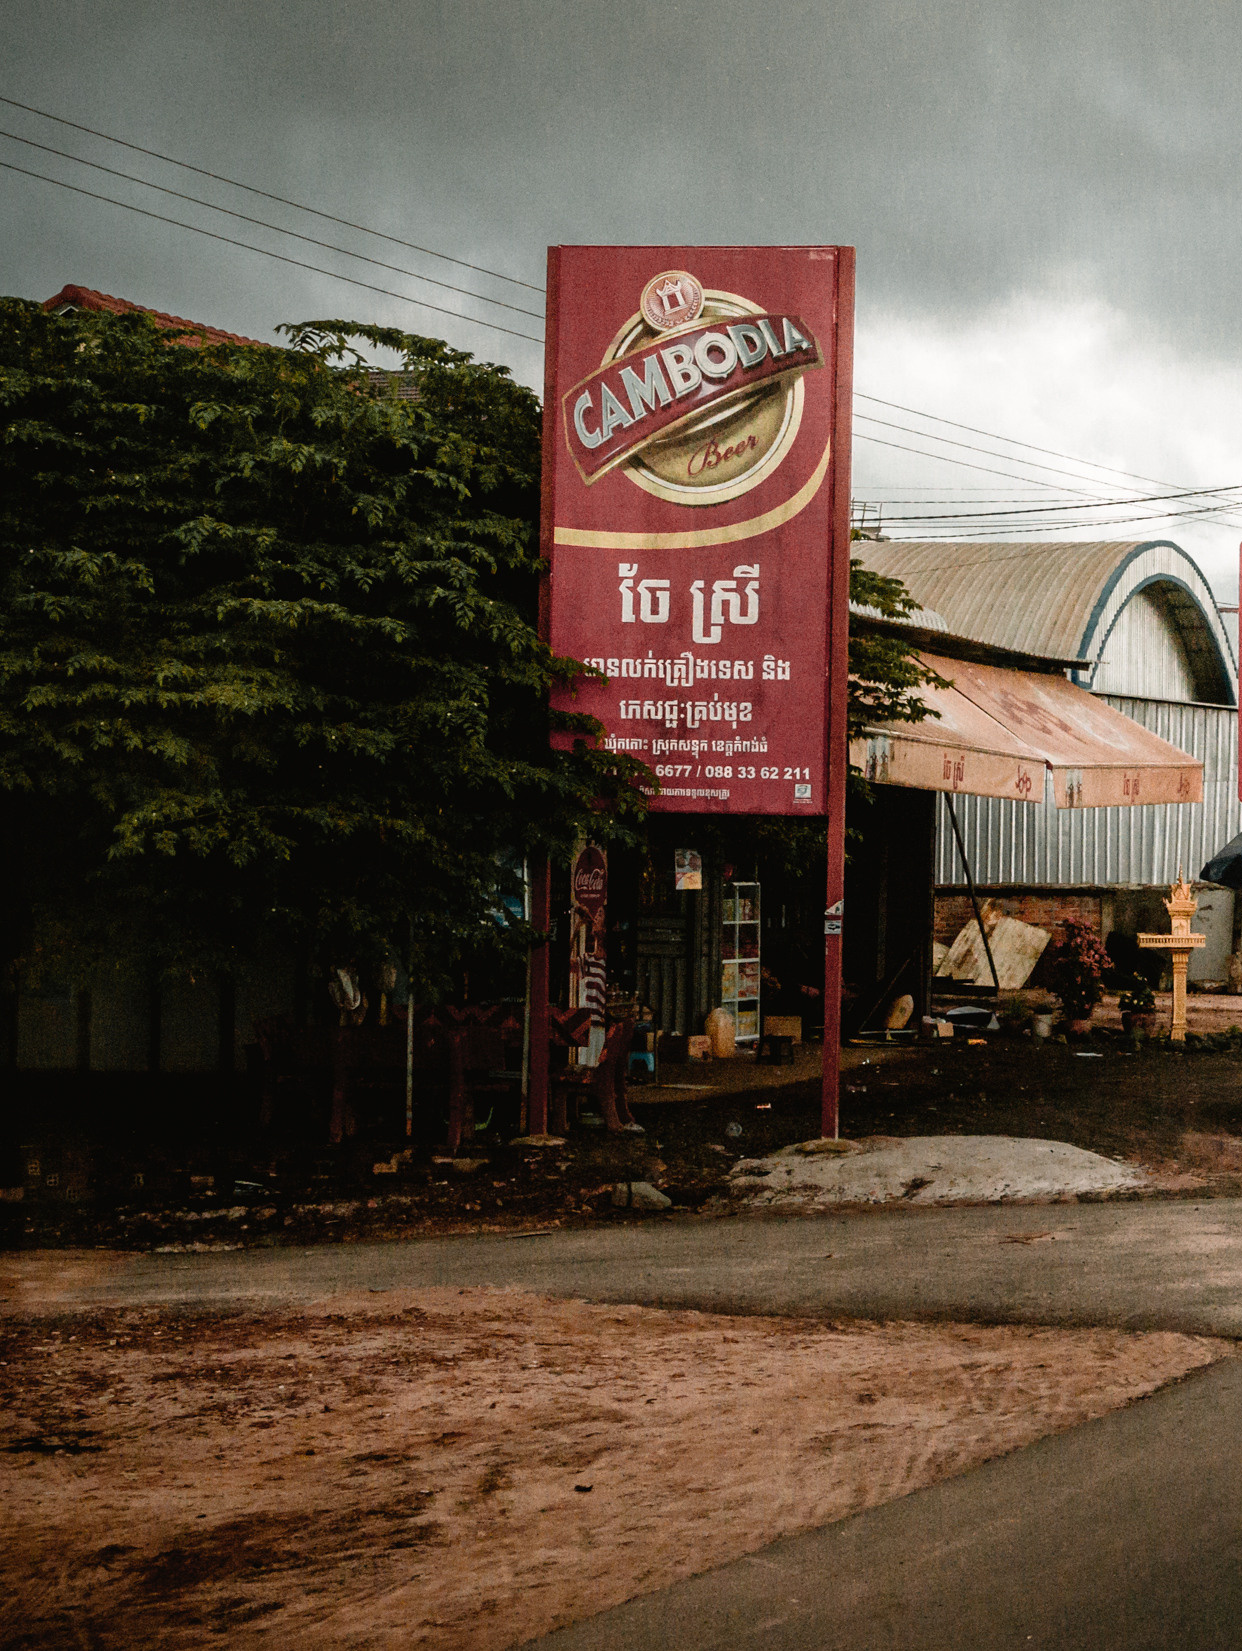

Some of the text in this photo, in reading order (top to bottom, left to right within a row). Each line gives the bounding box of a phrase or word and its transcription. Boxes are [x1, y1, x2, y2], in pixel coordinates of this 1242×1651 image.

[573, 317, 813, 449] CAMBODIA
[687, 432, 759, 476] Beer
[690, 564, 760, 644] ស្រី
[762, 655, 790, 681] និង
[656, 765, 692, 777] 6677
[705, 766, 732, 778] 088
[737, 766, 756, 779] 33
[760, 767, 779, 779] 62
[783, 767, 810, 780] 211
